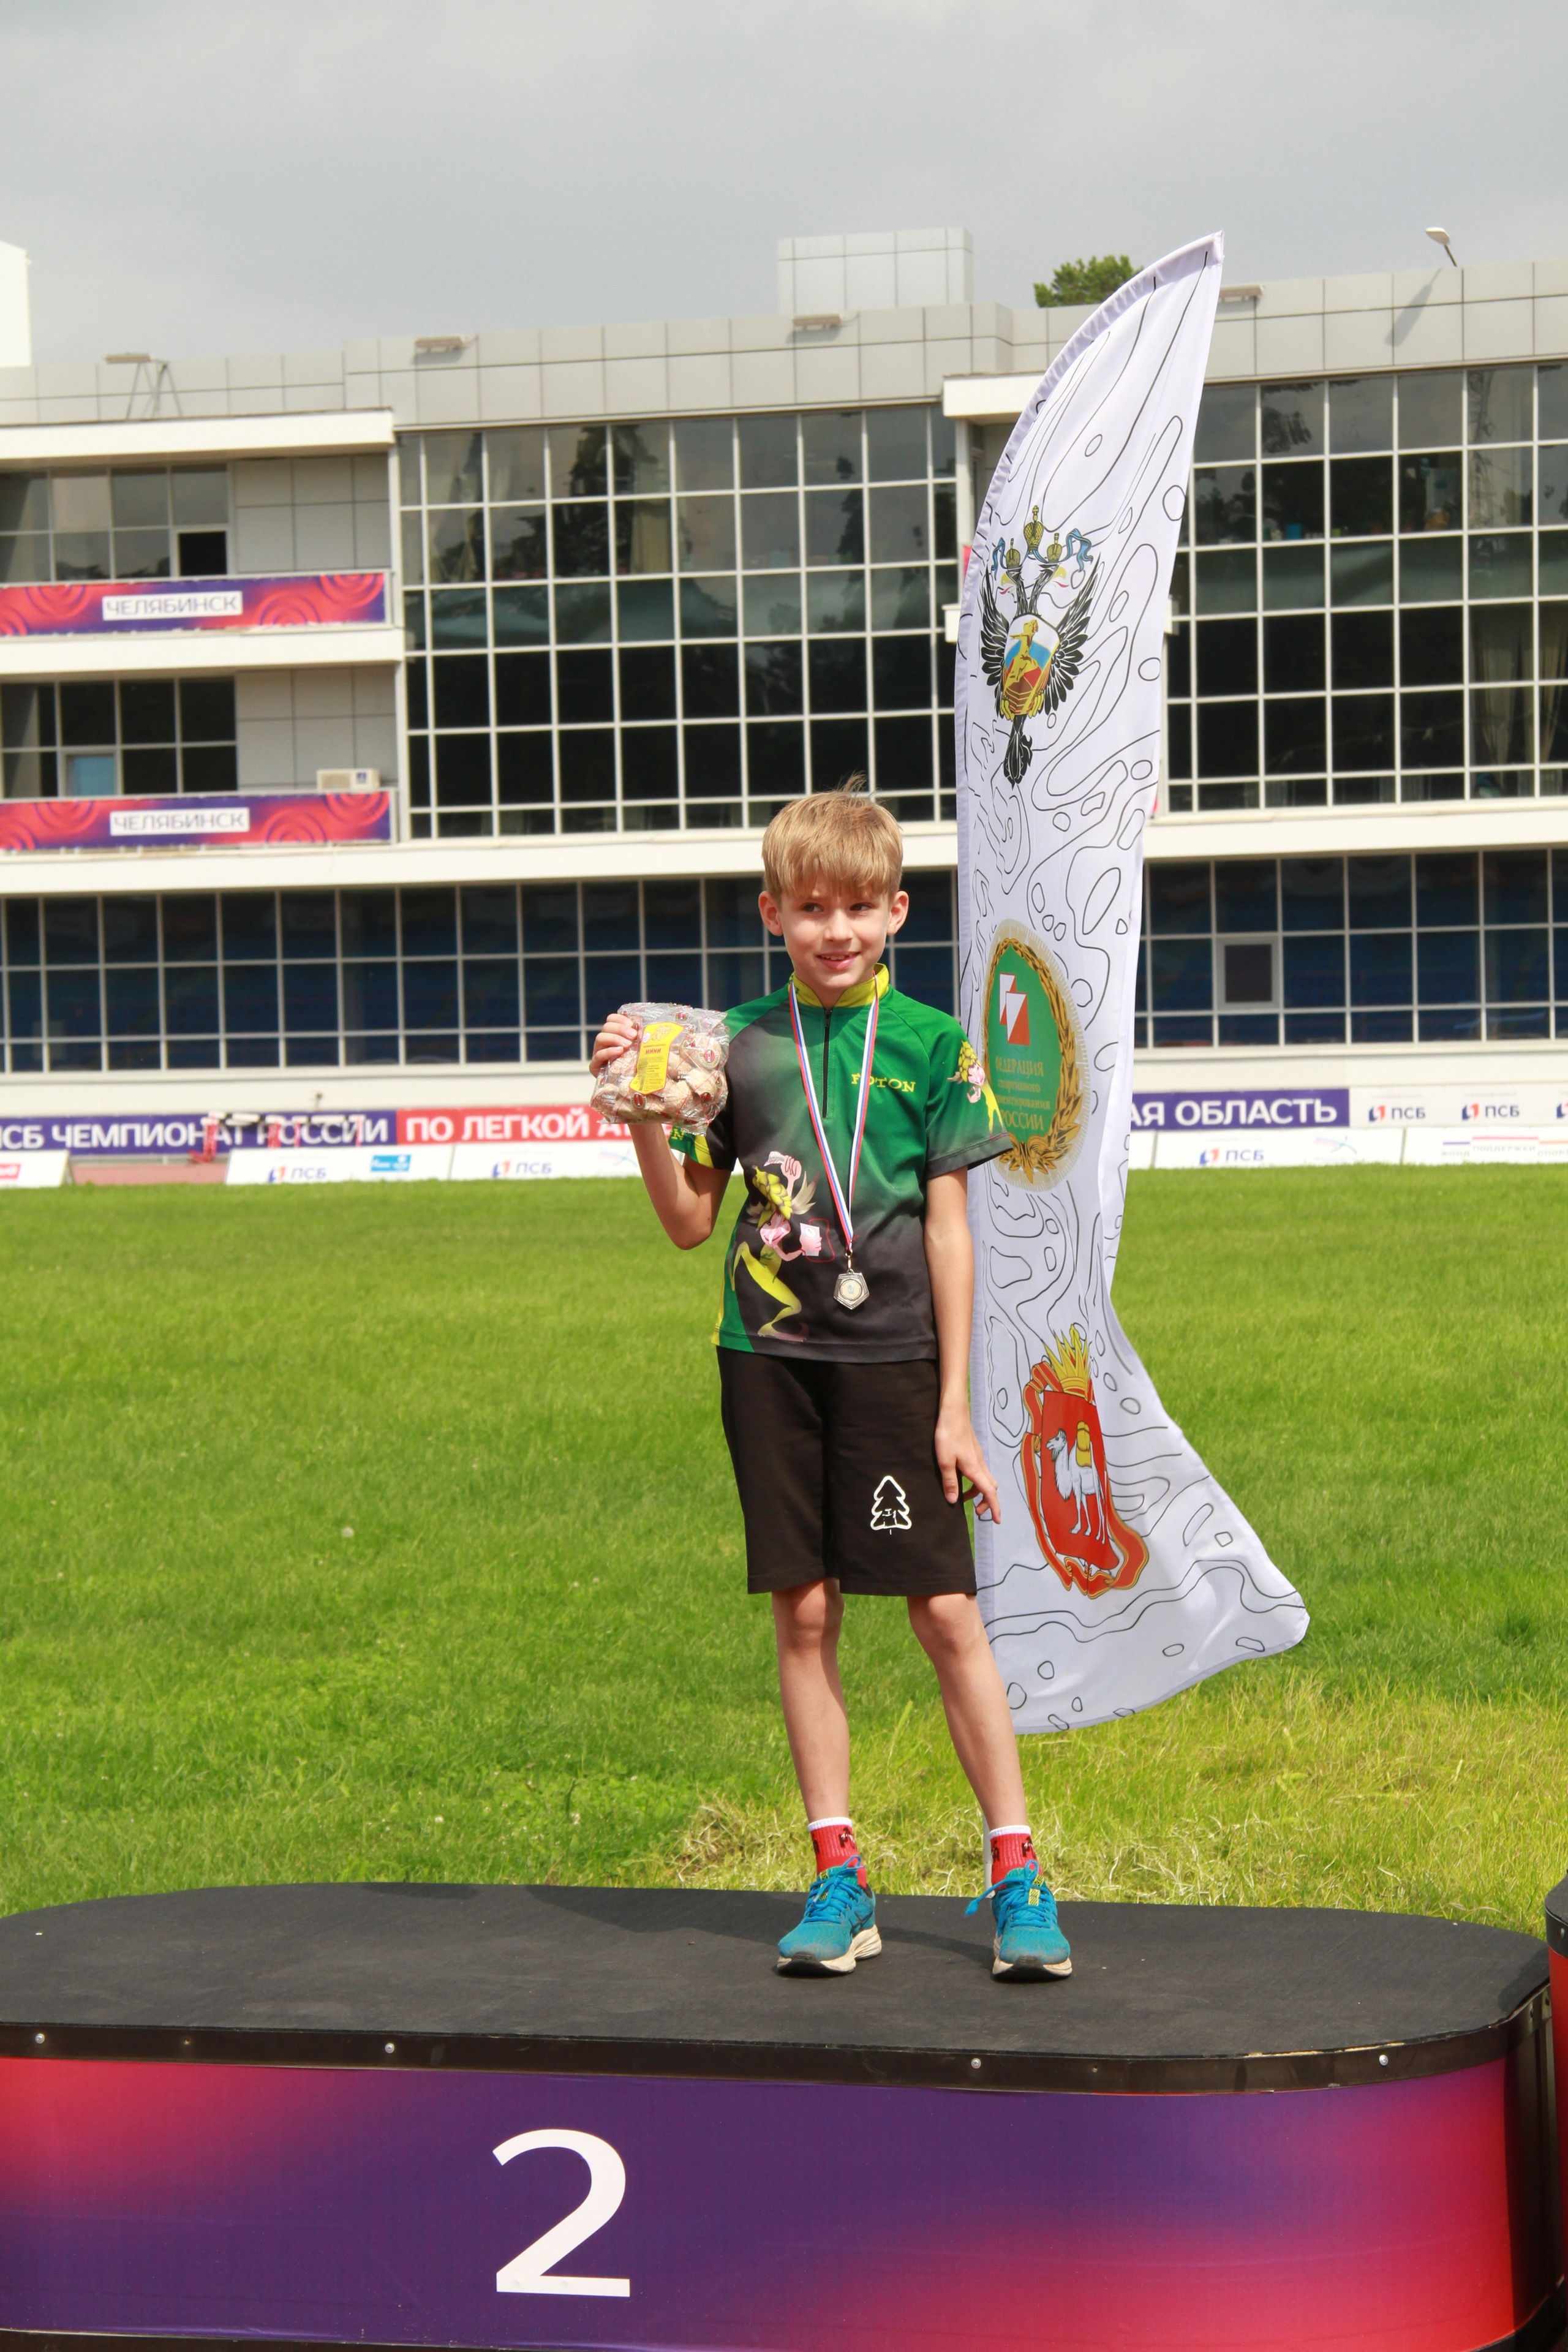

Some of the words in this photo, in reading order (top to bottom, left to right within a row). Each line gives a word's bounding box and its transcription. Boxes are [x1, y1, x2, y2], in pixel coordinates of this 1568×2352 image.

[107, 595, 238, 615] ЧЕЛЯБИНСК
[114, 812, 245, 831] ЧЕЛЯБИНСК
[1175, 1098, 1337, 1126] ОБЛАСТЬ
[1392, 1107, 1426, 1120] ПСБ
[1485, 1105, 1520, 1117] ПСБ
[406, 1117, 453, 1141] ПО
[462, 1108, 590, 1139] ЛЕГКОЙ
[0, 1125, 45, 1149] СБ
[1226, 1150, 1265, 1162] ПСБ
[291, 1167, 326, 1179] ПСБ
[516, 1162, 552, 1174] ПСБ
[492, 2129, 630, 2297] 2
